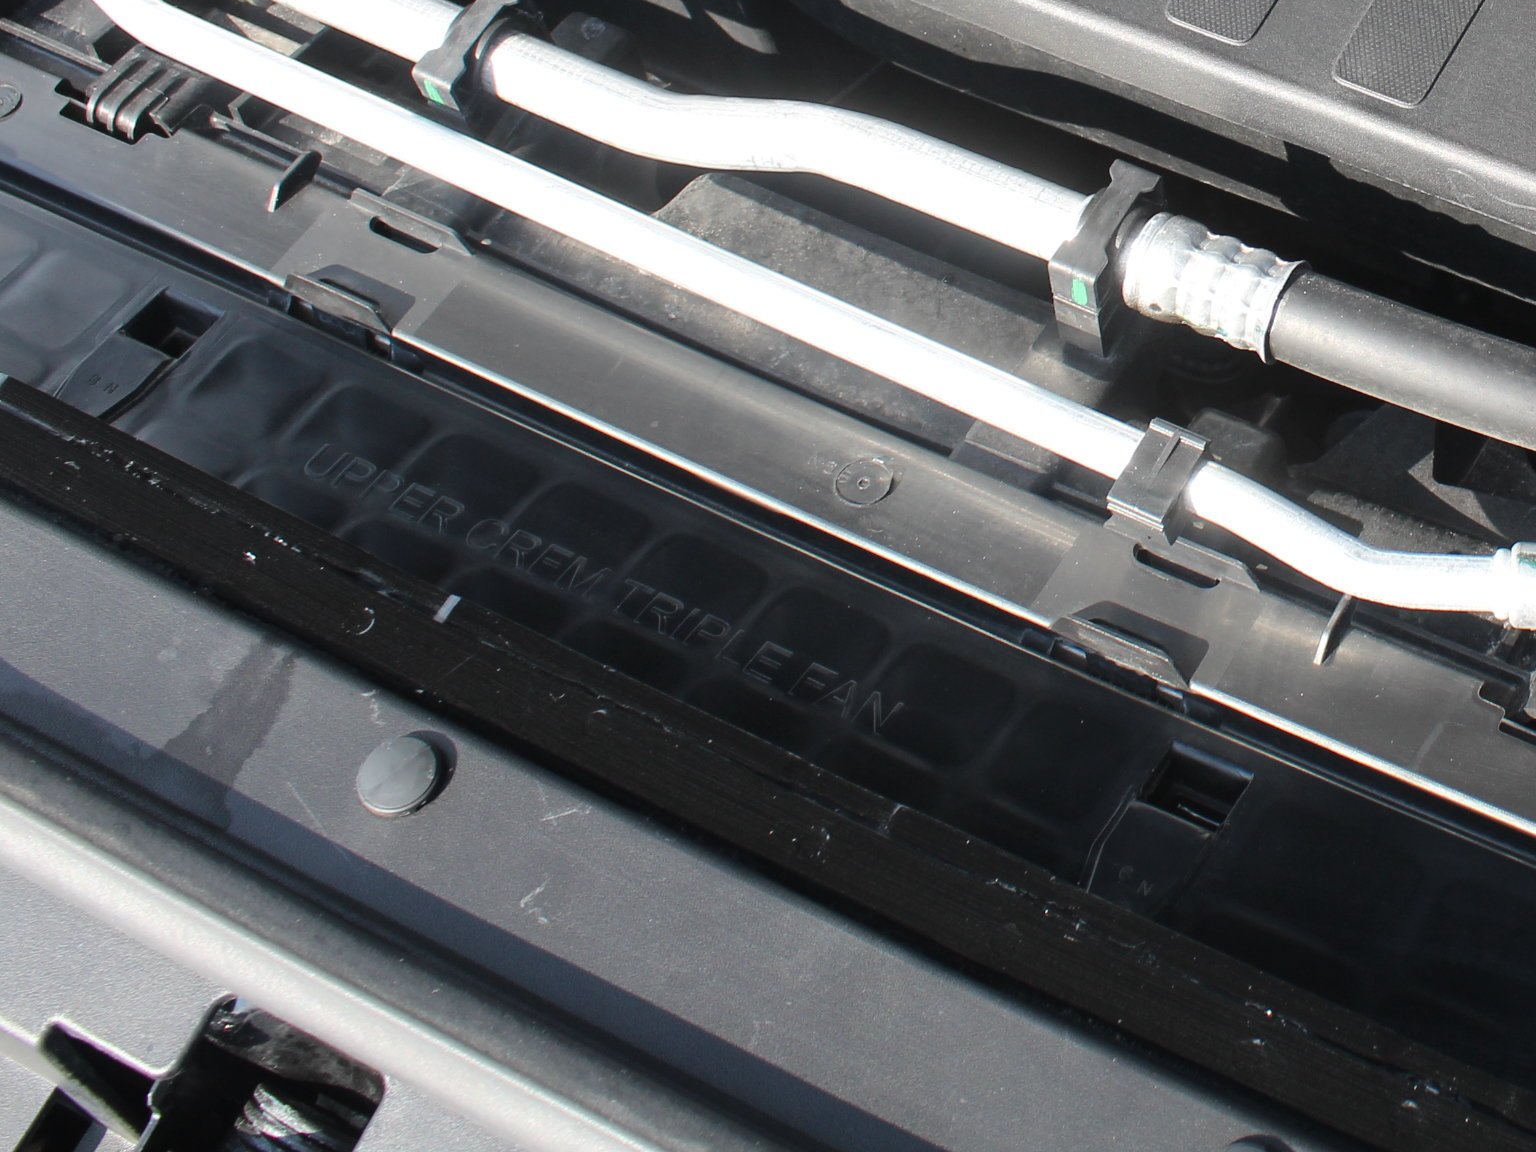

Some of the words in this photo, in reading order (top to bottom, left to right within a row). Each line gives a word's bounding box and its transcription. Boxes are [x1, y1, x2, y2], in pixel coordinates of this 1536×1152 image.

[303, 442, 467, 536] UPPER
[612, 578, 794, 686] TRIPLE
[787, 662, 904, 736] FAN
